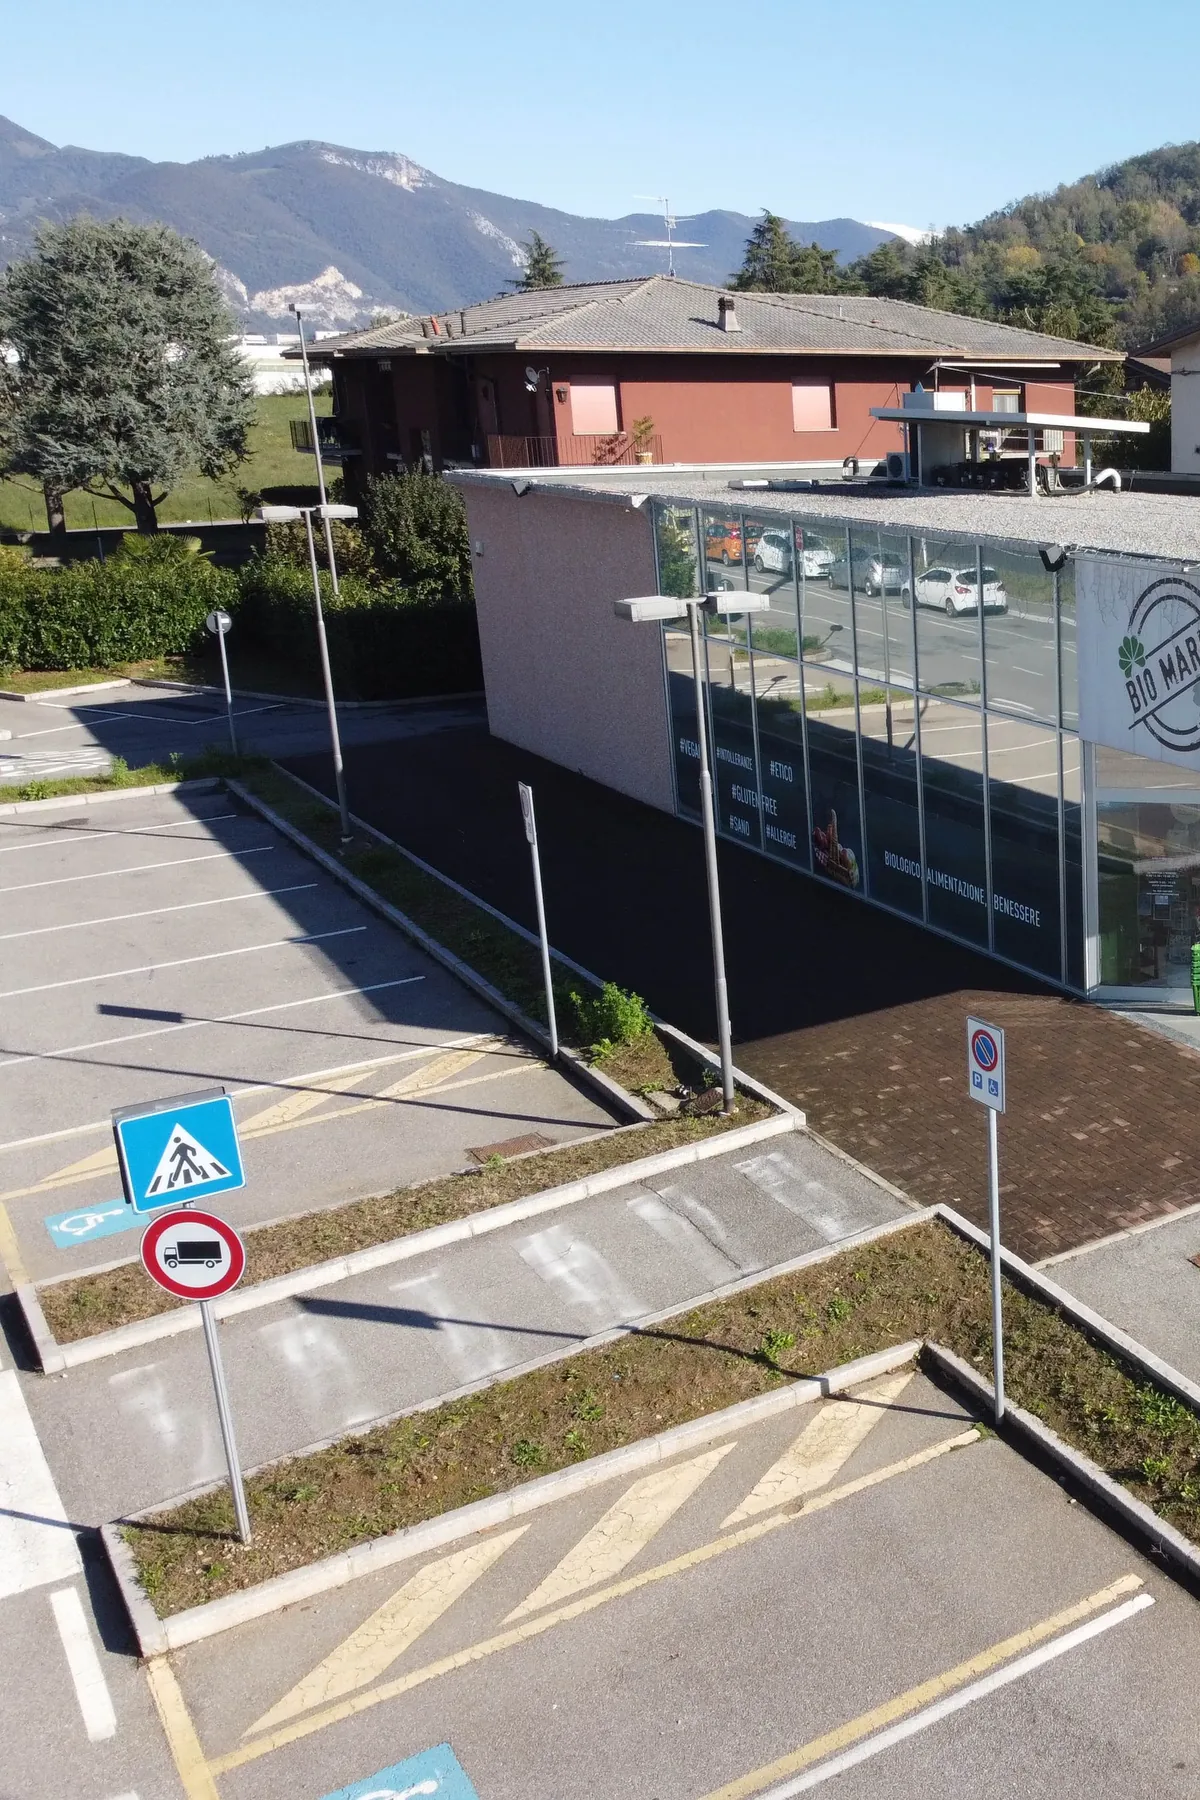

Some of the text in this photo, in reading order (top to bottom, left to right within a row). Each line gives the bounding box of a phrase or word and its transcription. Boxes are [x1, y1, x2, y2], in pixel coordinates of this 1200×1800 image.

[1125, 668, 1158, 714] BIO
[679, 738, 701, 760] #VEGA
[769, 760, 793, 783] #ETICO
[761, 794, 778, 817] FREE
[729, 814, 750, 836] #SANO
[765, 823, 797, 850] #ALLERGIE
[926, 867, 987, 908] ALIMENTAZIONE,
[993, 893, 1041, 928] BENESSERE
